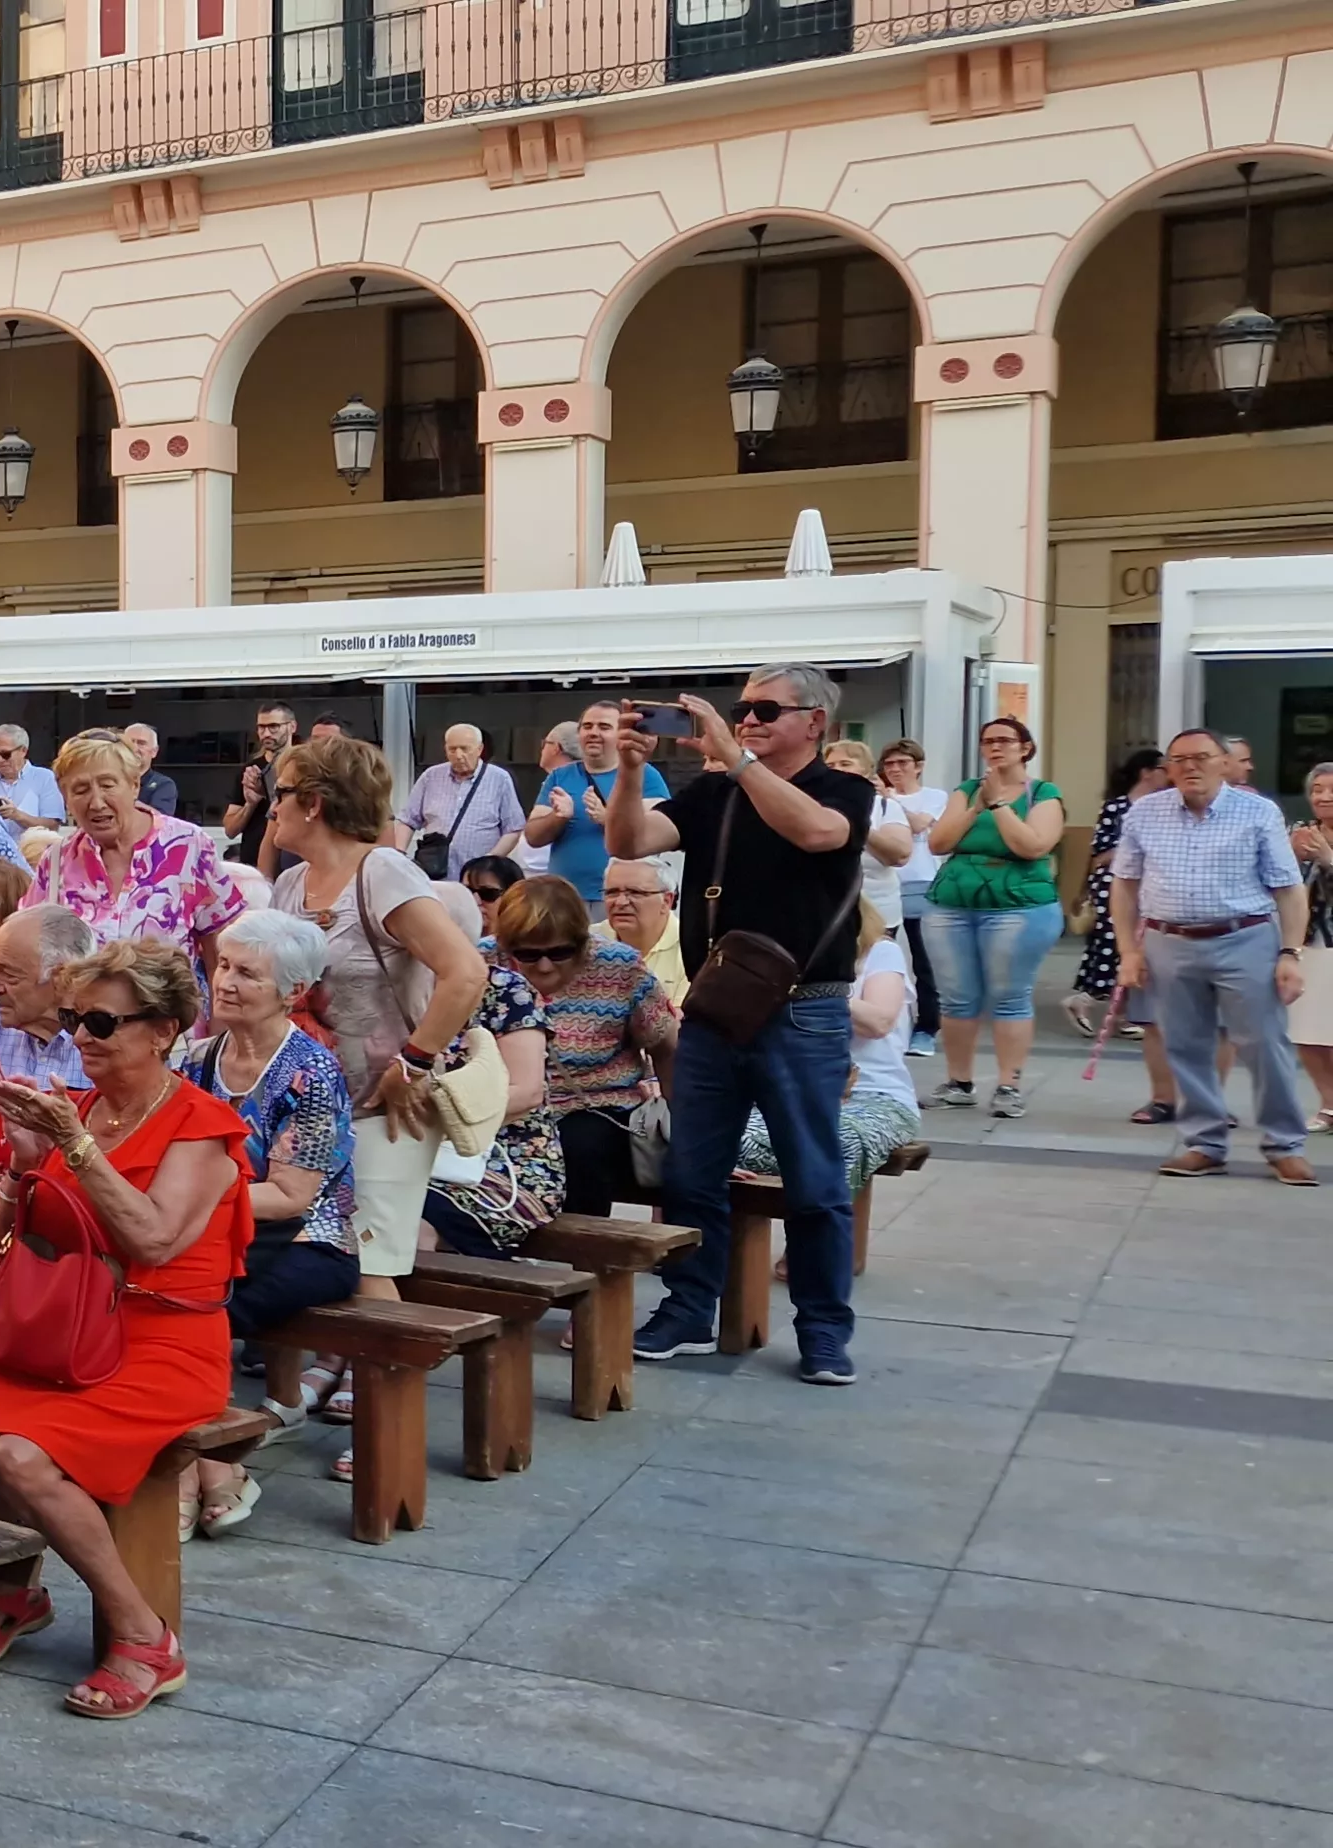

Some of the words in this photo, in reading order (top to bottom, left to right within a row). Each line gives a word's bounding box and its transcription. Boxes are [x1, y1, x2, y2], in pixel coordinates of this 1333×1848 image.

[1121, 567, 1160, 597] CO
[321, 636, 366, 651] Consello
[388, 634, 416, 648] Fabla
[418, 633, 476, 648] Aragonesa
